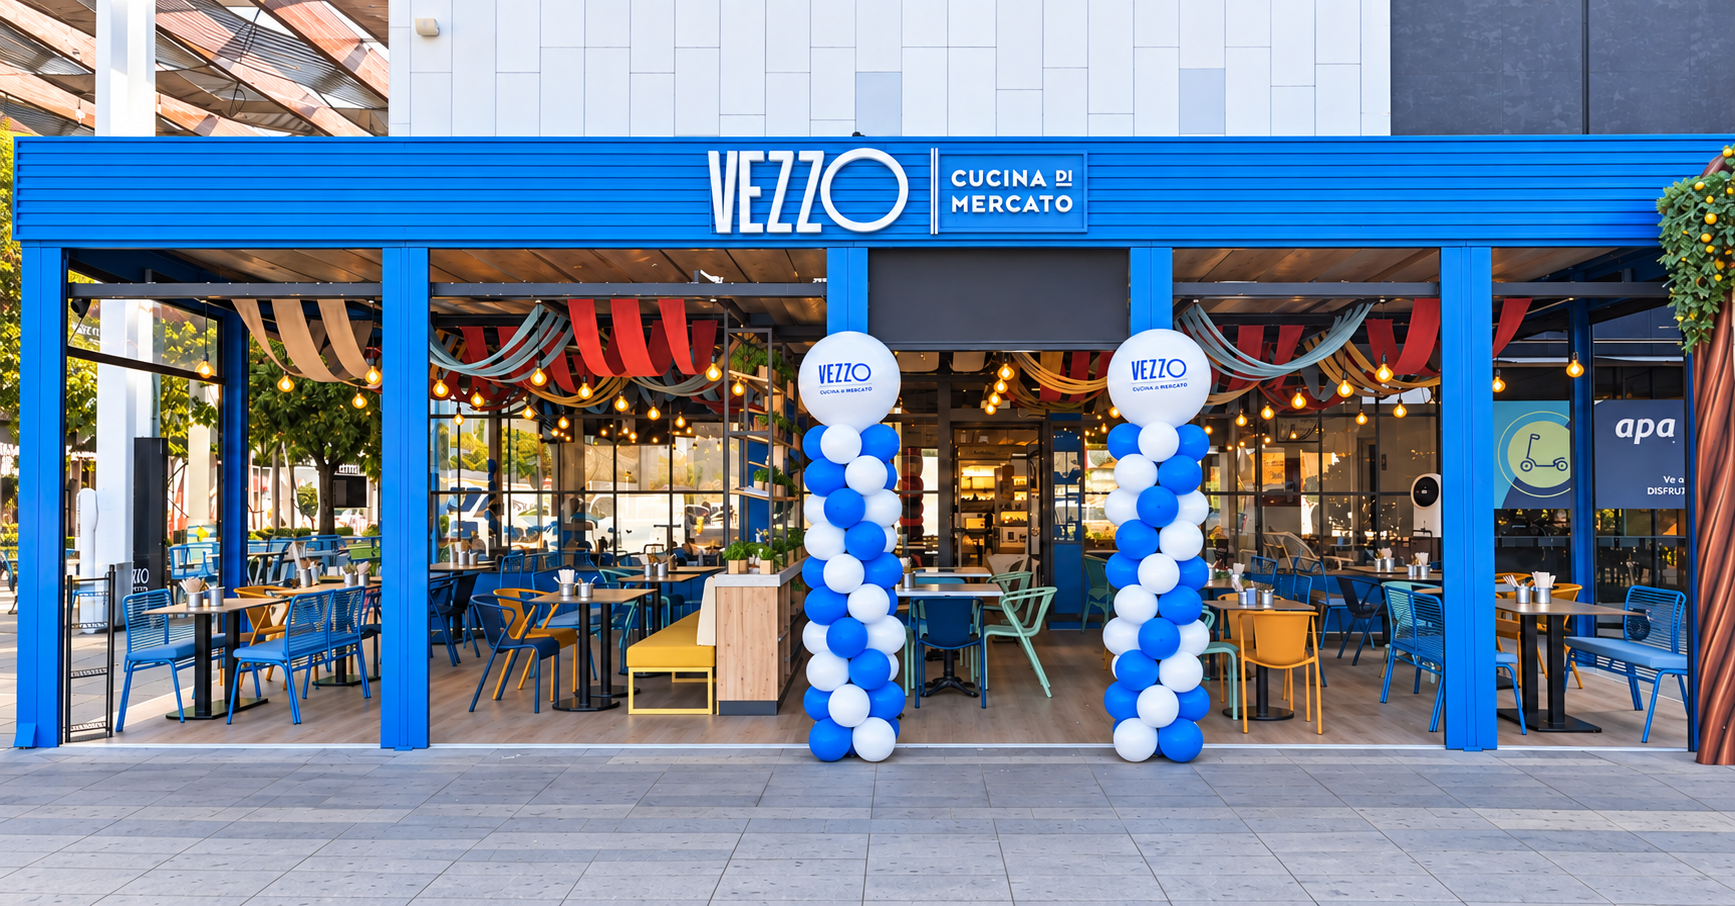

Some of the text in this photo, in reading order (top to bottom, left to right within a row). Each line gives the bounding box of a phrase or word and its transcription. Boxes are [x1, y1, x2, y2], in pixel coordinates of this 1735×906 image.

[951, 169, 1073, 187] CUCINA DI
[708, 147, 909, 234] VEZZO
[951, 194, 1073, 213] MERCATO
[818, 362, 872, 385] VEZZO
[1130, 358, 1187, 381] VEZZO
[1615, 418, 1676, 445] apa
[1663, 475, 1676, 484] Ve
